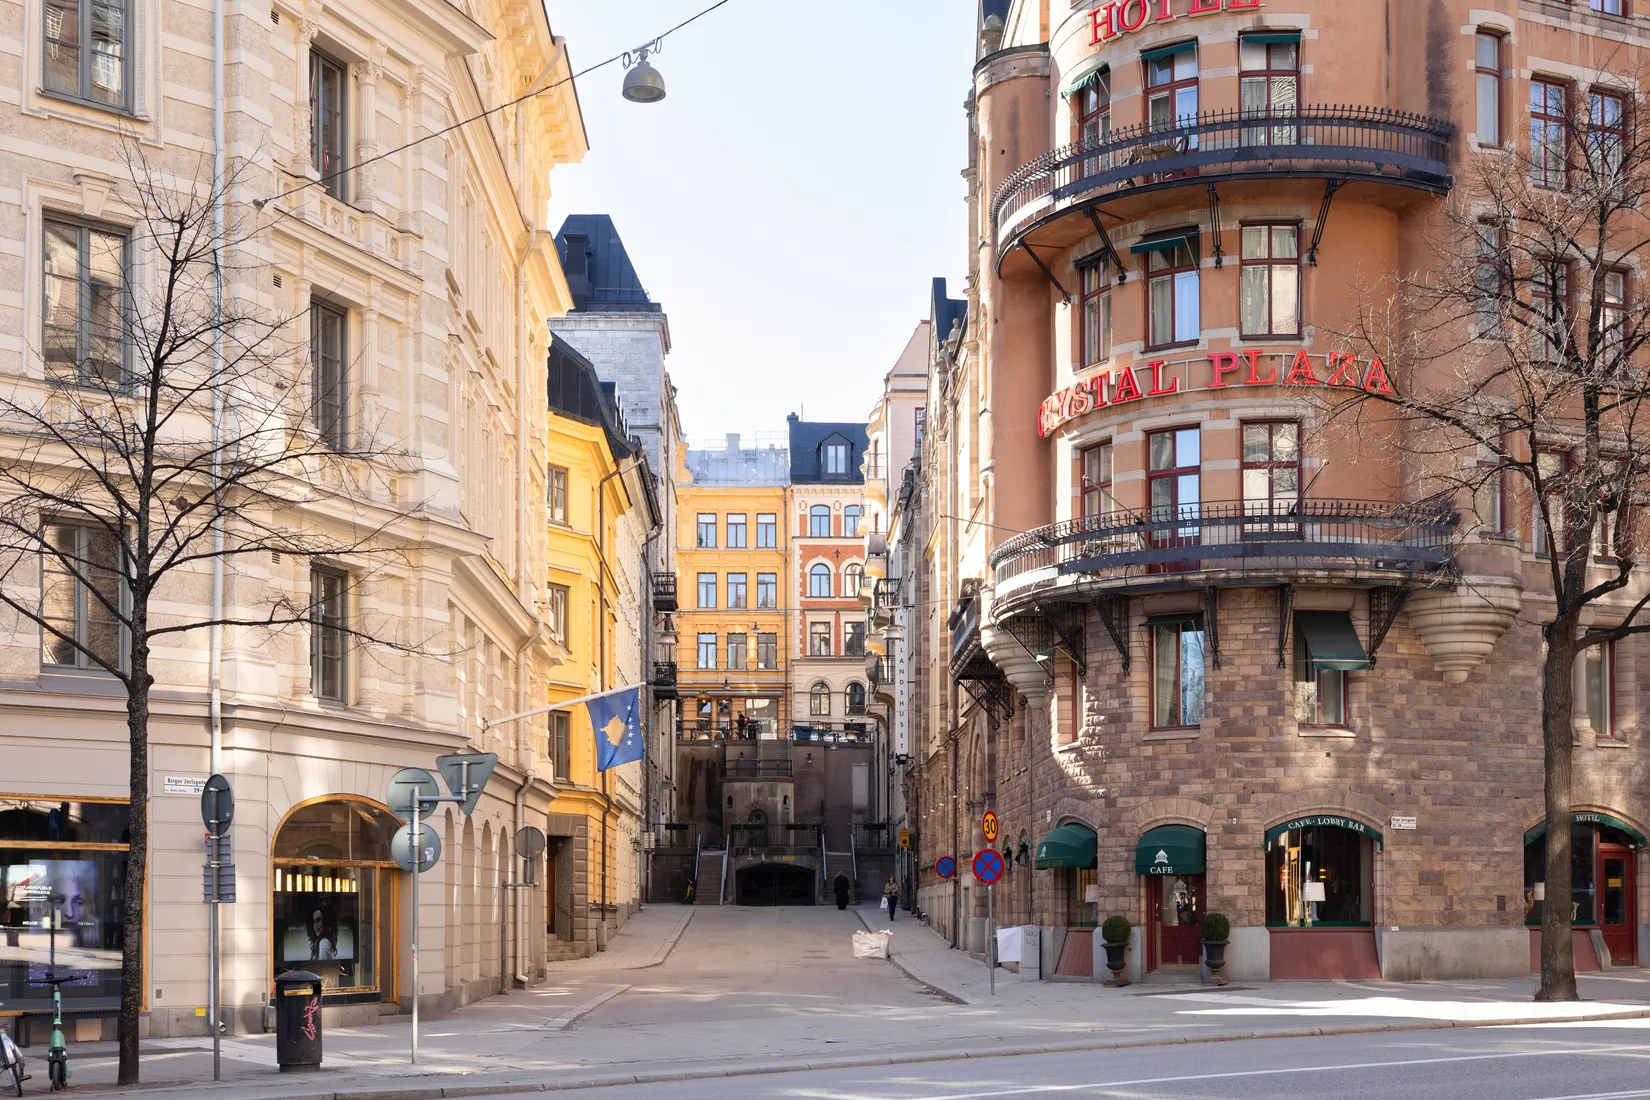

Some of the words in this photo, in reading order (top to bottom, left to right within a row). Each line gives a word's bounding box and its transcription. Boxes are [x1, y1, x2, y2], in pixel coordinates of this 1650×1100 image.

[1038, 360, 1178, 438] CRYSTAL
[1207, 350, 1392, 394] PLAZA
[1288, 819, 1312, 829] CAFE
[1317, 818, 1346, 827] LOBBY
[1348, 821, 1365, 832] BAR
[1576, 814, 1600, 822] HOTEL
[985, 818, 996, 834] 30
[1150, 866, 1173, 874] CAFE
